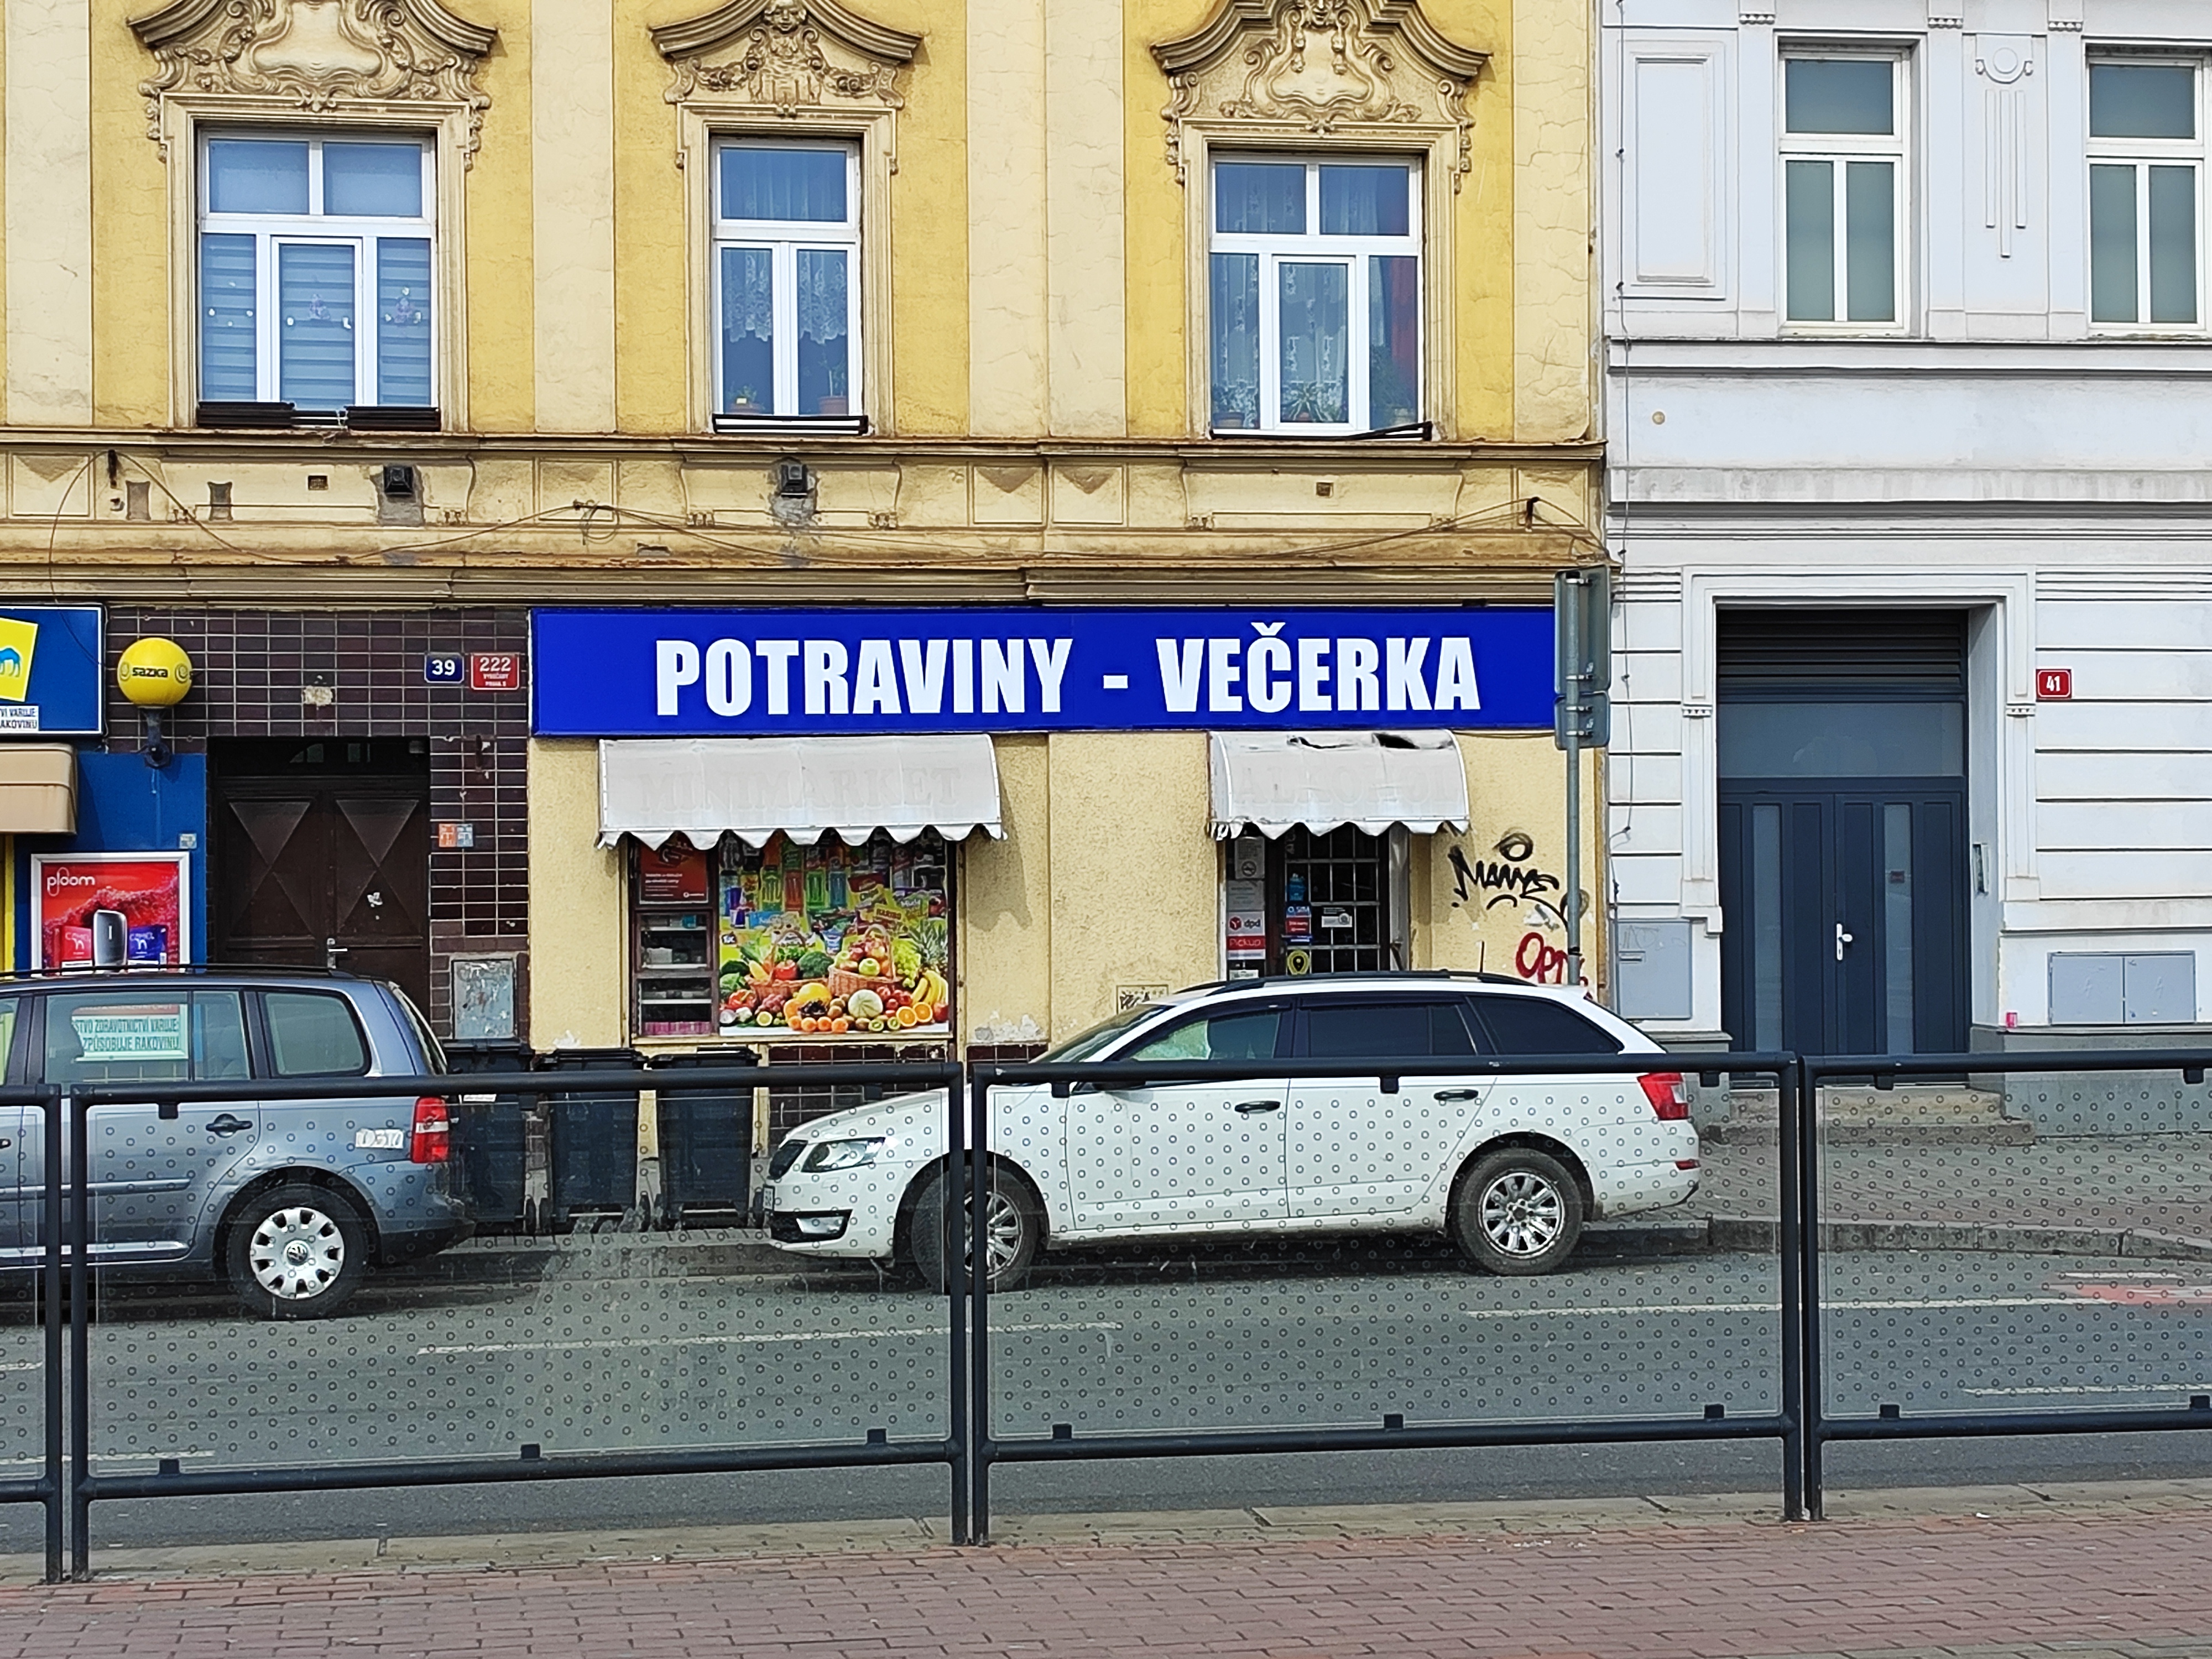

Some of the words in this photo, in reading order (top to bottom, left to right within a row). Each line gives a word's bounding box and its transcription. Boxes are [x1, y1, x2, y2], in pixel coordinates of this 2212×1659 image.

[132, 667, 168, 677] sazka
[432, 659, 455, 676] 39
[479, 656, 511, 672] 222
[656, 638, 1073, 717] POTRAVINY
[1103, 675, 1128, 688] -
[1156, 622, 1480, 713] VEČERKA
[2046, 676, 2060, 691] 41
[639, 767, 961, 812] MINIMARKET
[47, 867, 95, 896] ploom
[1244, 919, 1261, 929] dpd
